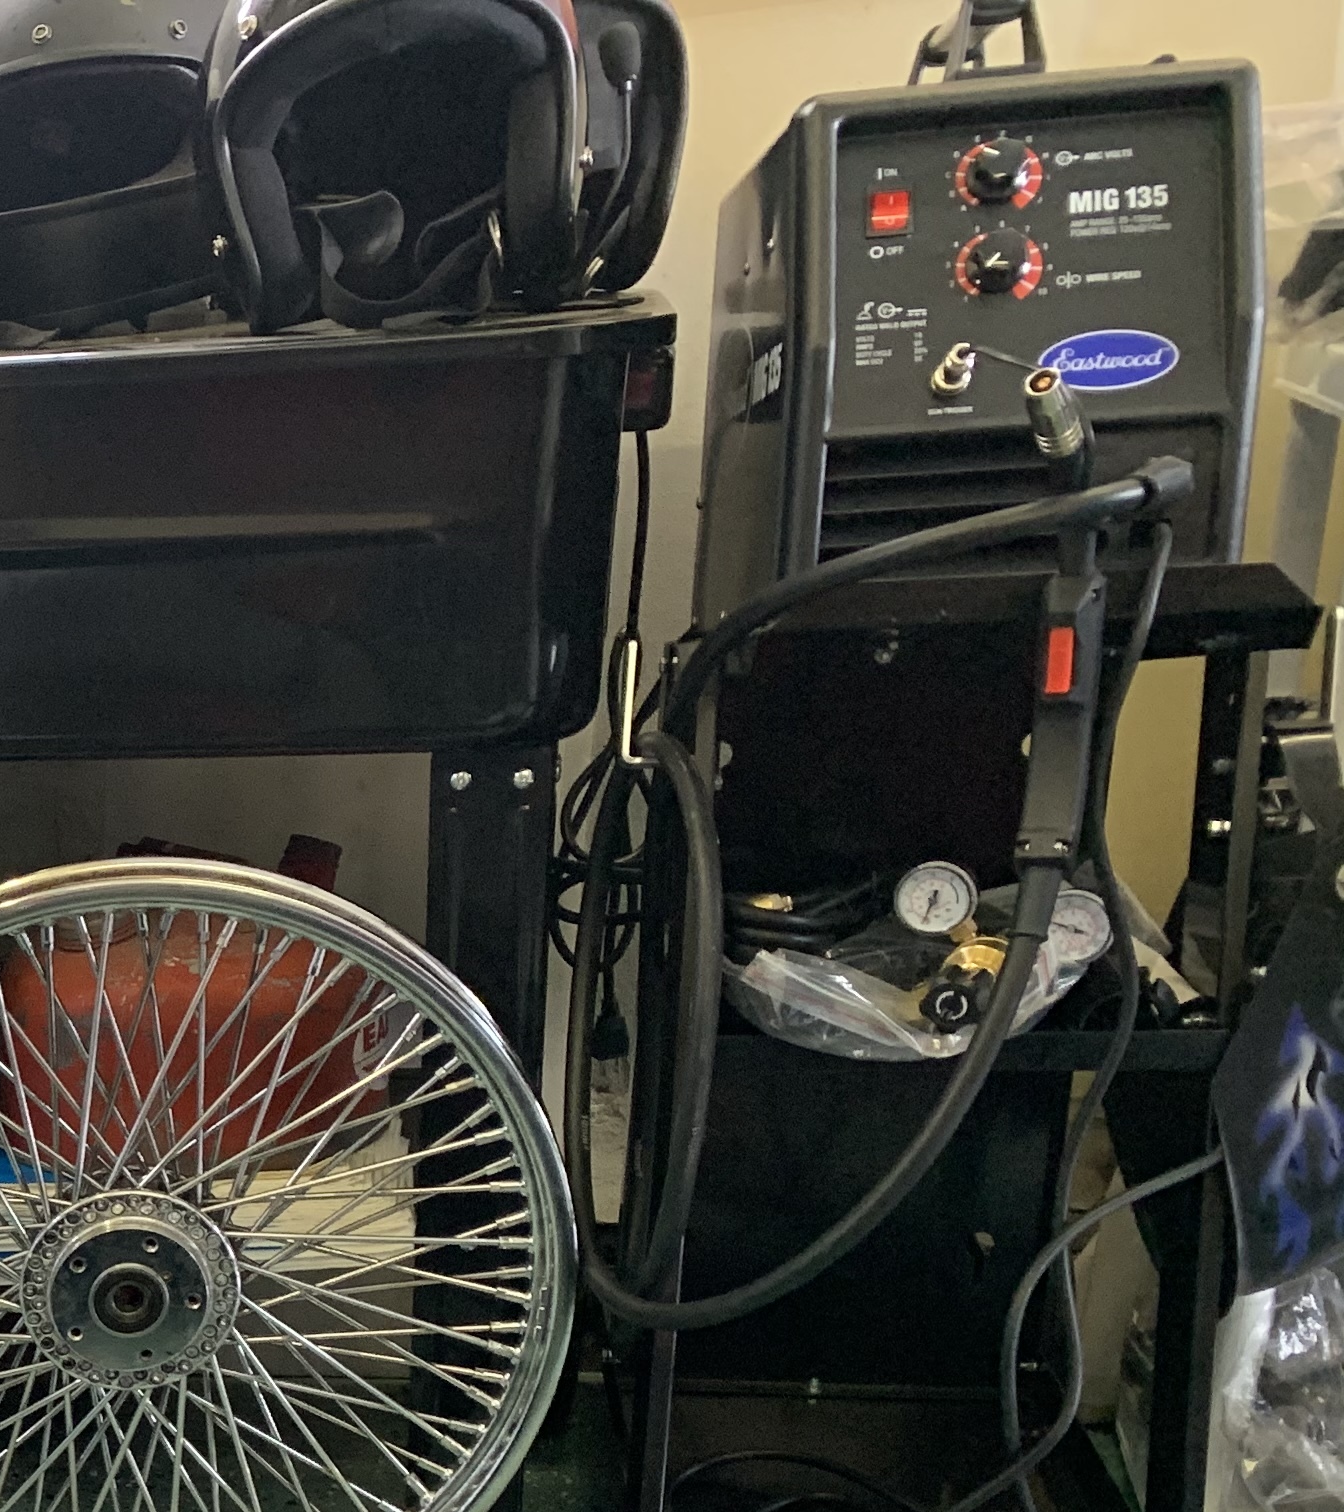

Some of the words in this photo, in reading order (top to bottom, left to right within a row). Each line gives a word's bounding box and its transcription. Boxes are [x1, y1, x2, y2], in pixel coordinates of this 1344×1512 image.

[1069, 188, 1120, 214] MIG
[1124, 184, 1170, 209] 135
[1052, 348, 1163, 372] Eastwood
